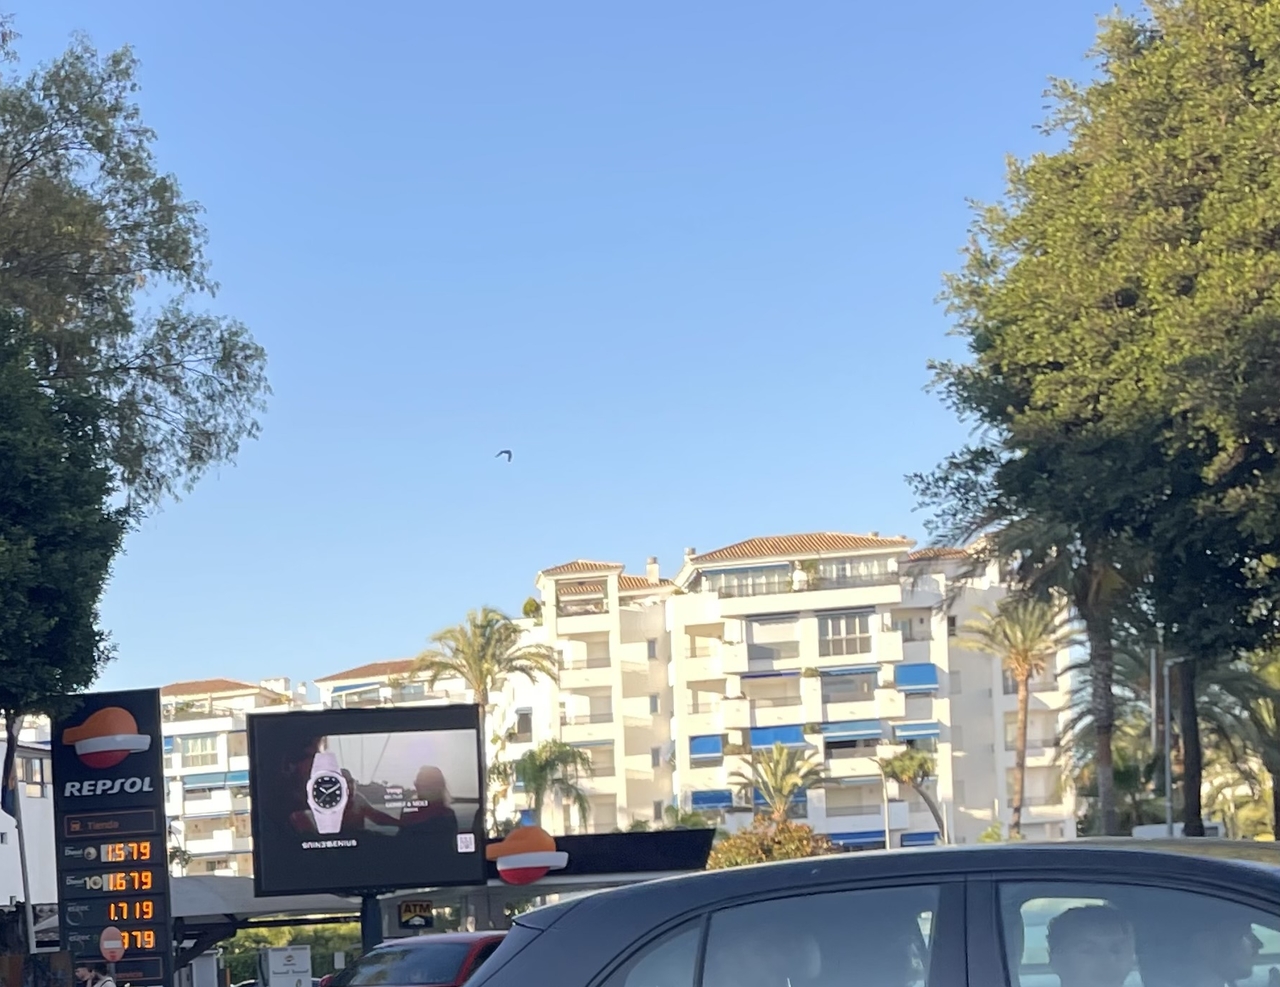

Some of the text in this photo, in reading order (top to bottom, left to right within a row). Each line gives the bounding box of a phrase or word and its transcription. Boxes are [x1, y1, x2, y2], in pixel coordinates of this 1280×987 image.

[64, 776, 154, 797] REPSOL
[110, 901, 153, 920] 1.719
[404, 903, 430, 913] ATM
